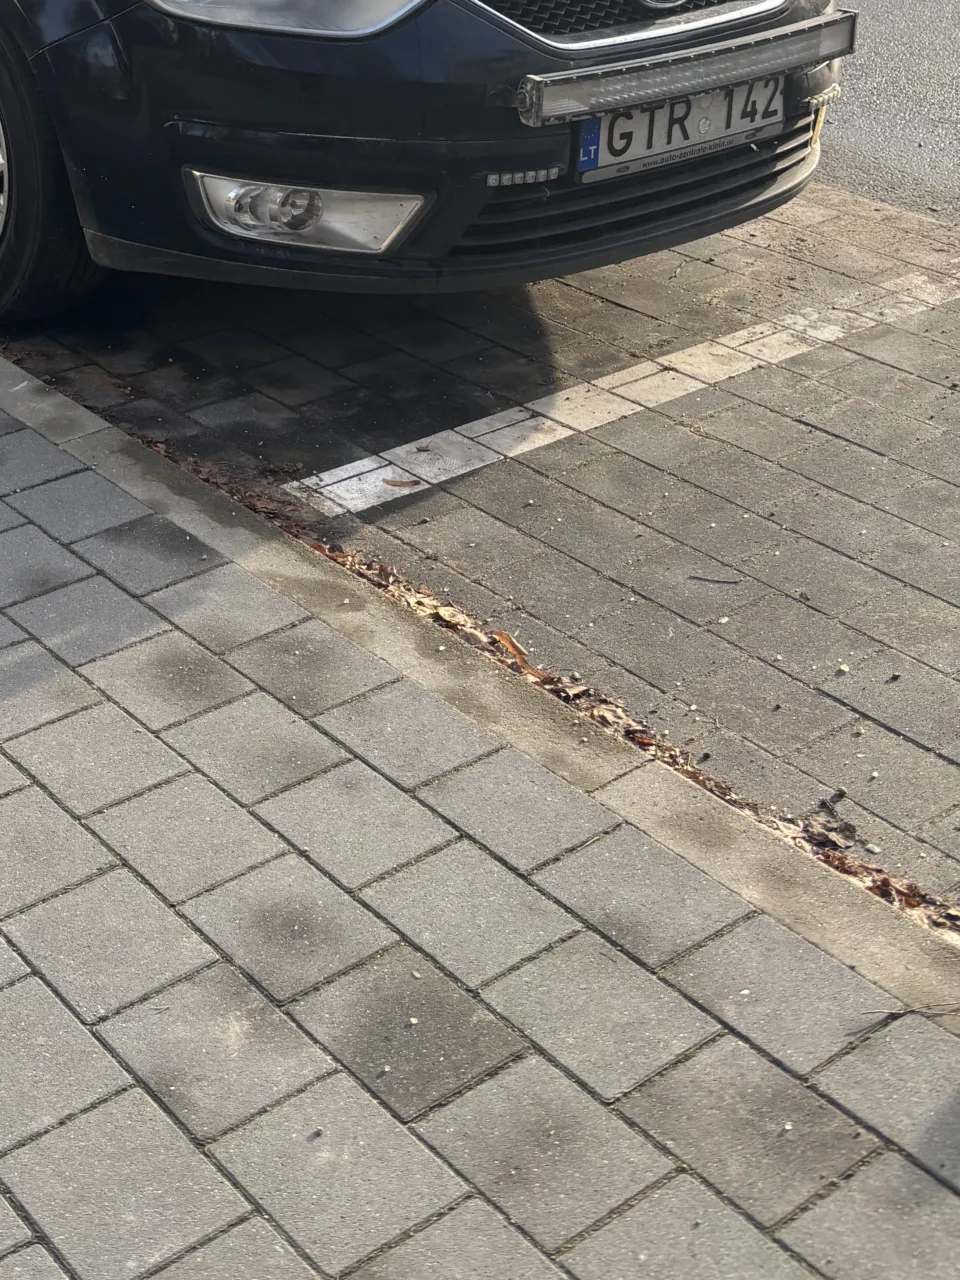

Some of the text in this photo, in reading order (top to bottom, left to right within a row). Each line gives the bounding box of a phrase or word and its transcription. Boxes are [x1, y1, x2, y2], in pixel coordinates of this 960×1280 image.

[607, 77, 780, 158] GTR 142
[580, 145, 597, 161] LT
